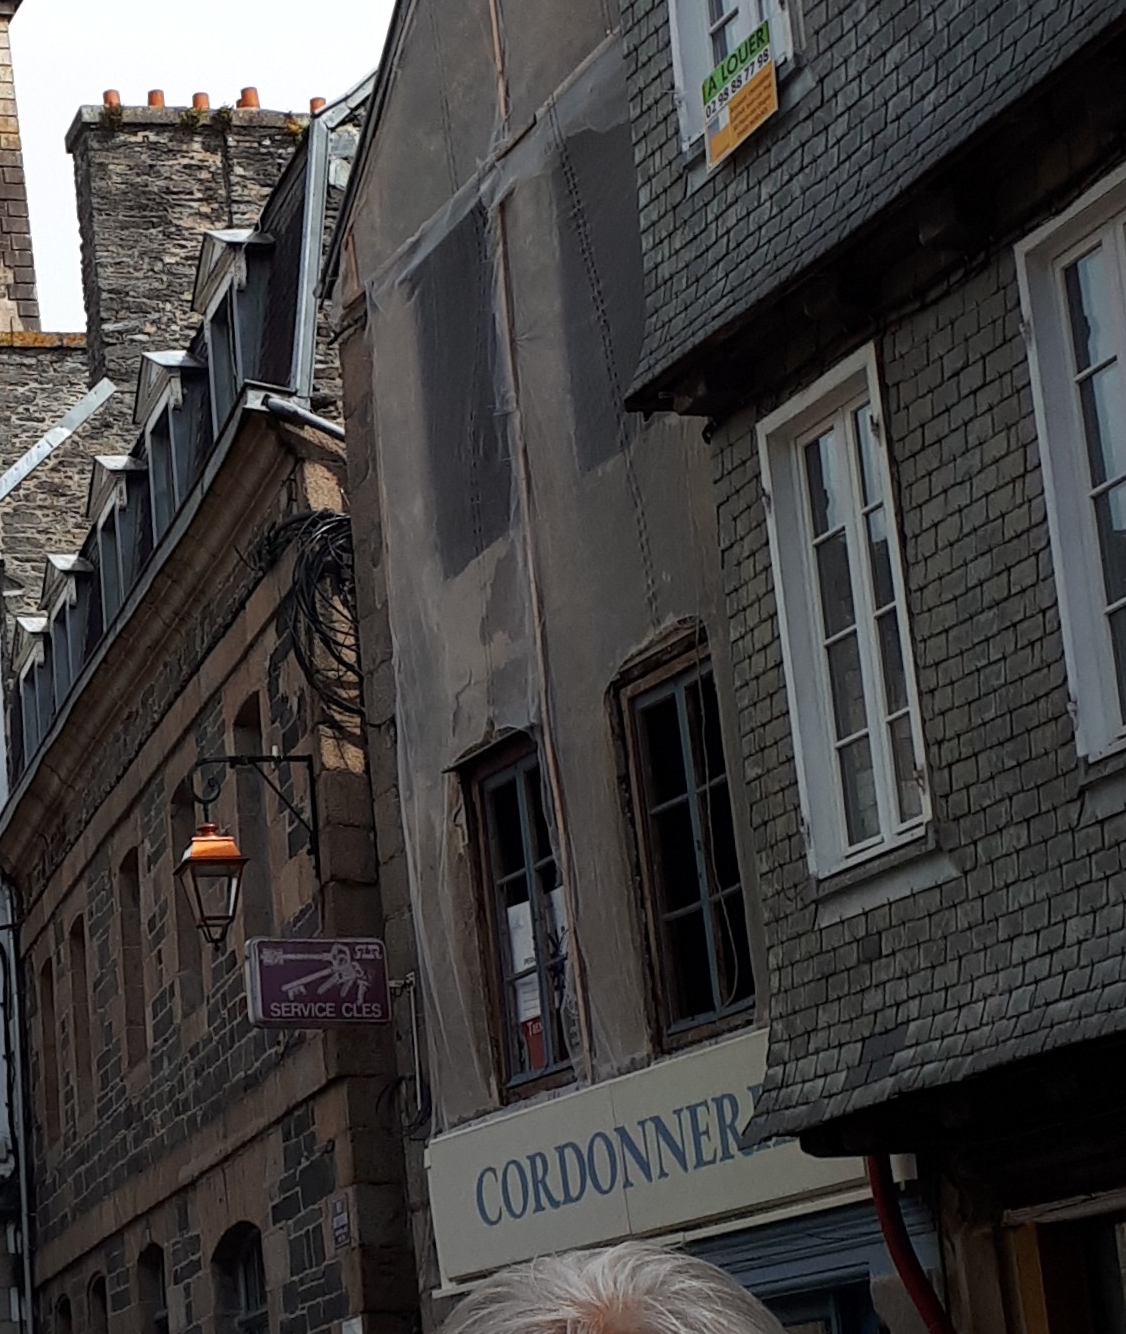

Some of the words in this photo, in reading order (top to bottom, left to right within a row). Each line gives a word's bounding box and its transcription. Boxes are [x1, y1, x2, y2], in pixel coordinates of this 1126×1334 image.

[706, 100, 717, 119] 02
[744, 61, 755, 81] 77
[707, 75, 717, 96] A
[721, 27, 765, 80] LOUER
[270, 1002, 336, 1017] SERVICE
[342, 1002, 382, 1017] CLES
[476, 1080, 796, 1226] CORDONNER
